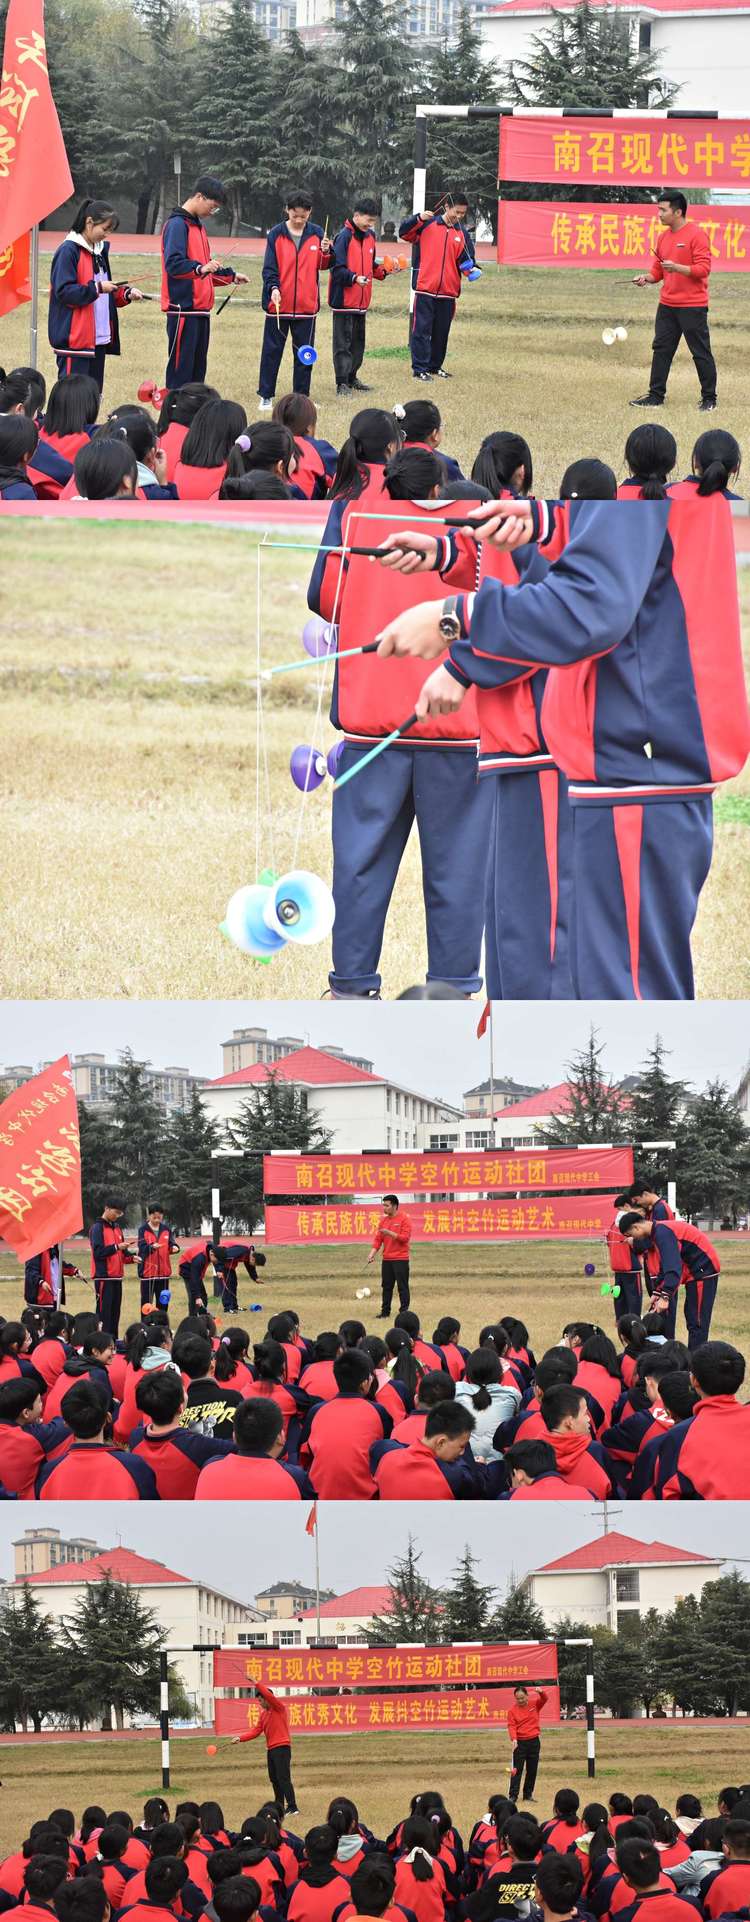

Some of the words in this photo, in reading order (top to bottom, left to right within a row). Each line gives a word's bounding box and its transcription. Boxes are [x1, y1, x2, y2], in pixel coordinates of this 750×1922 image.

[551, 130, 750, 177] 南召现代中学
[295, 1159, 546, 1188] 南召现代中学空竹运动社团
[297, 1210, 381, 1236] 传承民族优秀
[422, 1206, 555, 1233] 发展抖空竹运动艺术
[245, 1654, 481, 1682] 南召现代中学空竹运动社团
[246, 1701, 358, 1729] 传族优秀文化
[368, 1696, 490, 1724] 发展抖空竹运动艺术
[499, 1883, 536, 1892] DIRECT
